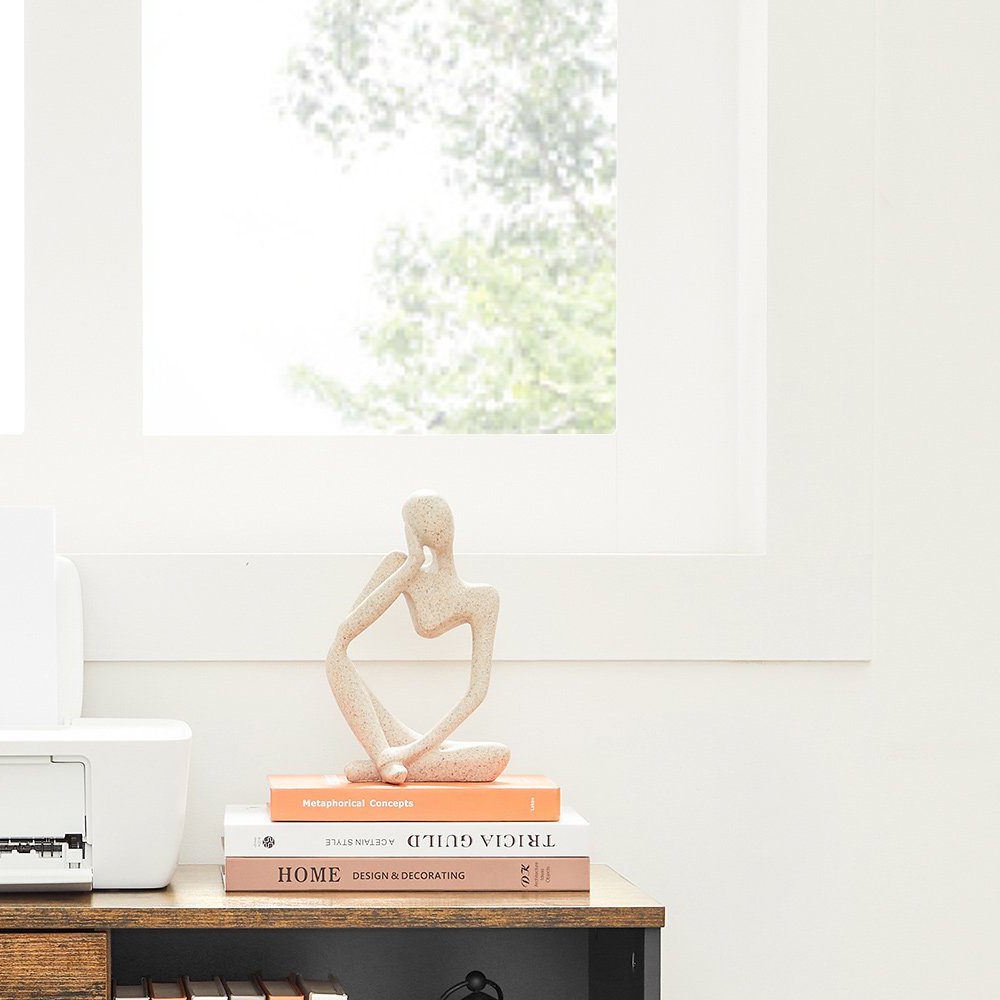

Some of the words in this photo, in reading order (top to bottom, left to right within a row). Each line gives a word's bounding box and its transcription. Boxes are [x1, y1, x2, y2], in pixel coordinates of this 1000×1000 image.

[303, 799, 365, 808] Metaphorical
[369, 799, 414, 808] Concepts
[325, 838, 354, 846] STYLE
[355, 838, 388, 846] CETAIN
[388, 838, 395, 846] A
[407, 834, 473, 848] GUILD
[480, 834, 556, 848] TRICIA
[278, 866, 341, 883] HOME
[352, 871, 389, 880] DESIGN
[391, 871, 400, 880] &
[401, 871, 466, 880] DECORATING
